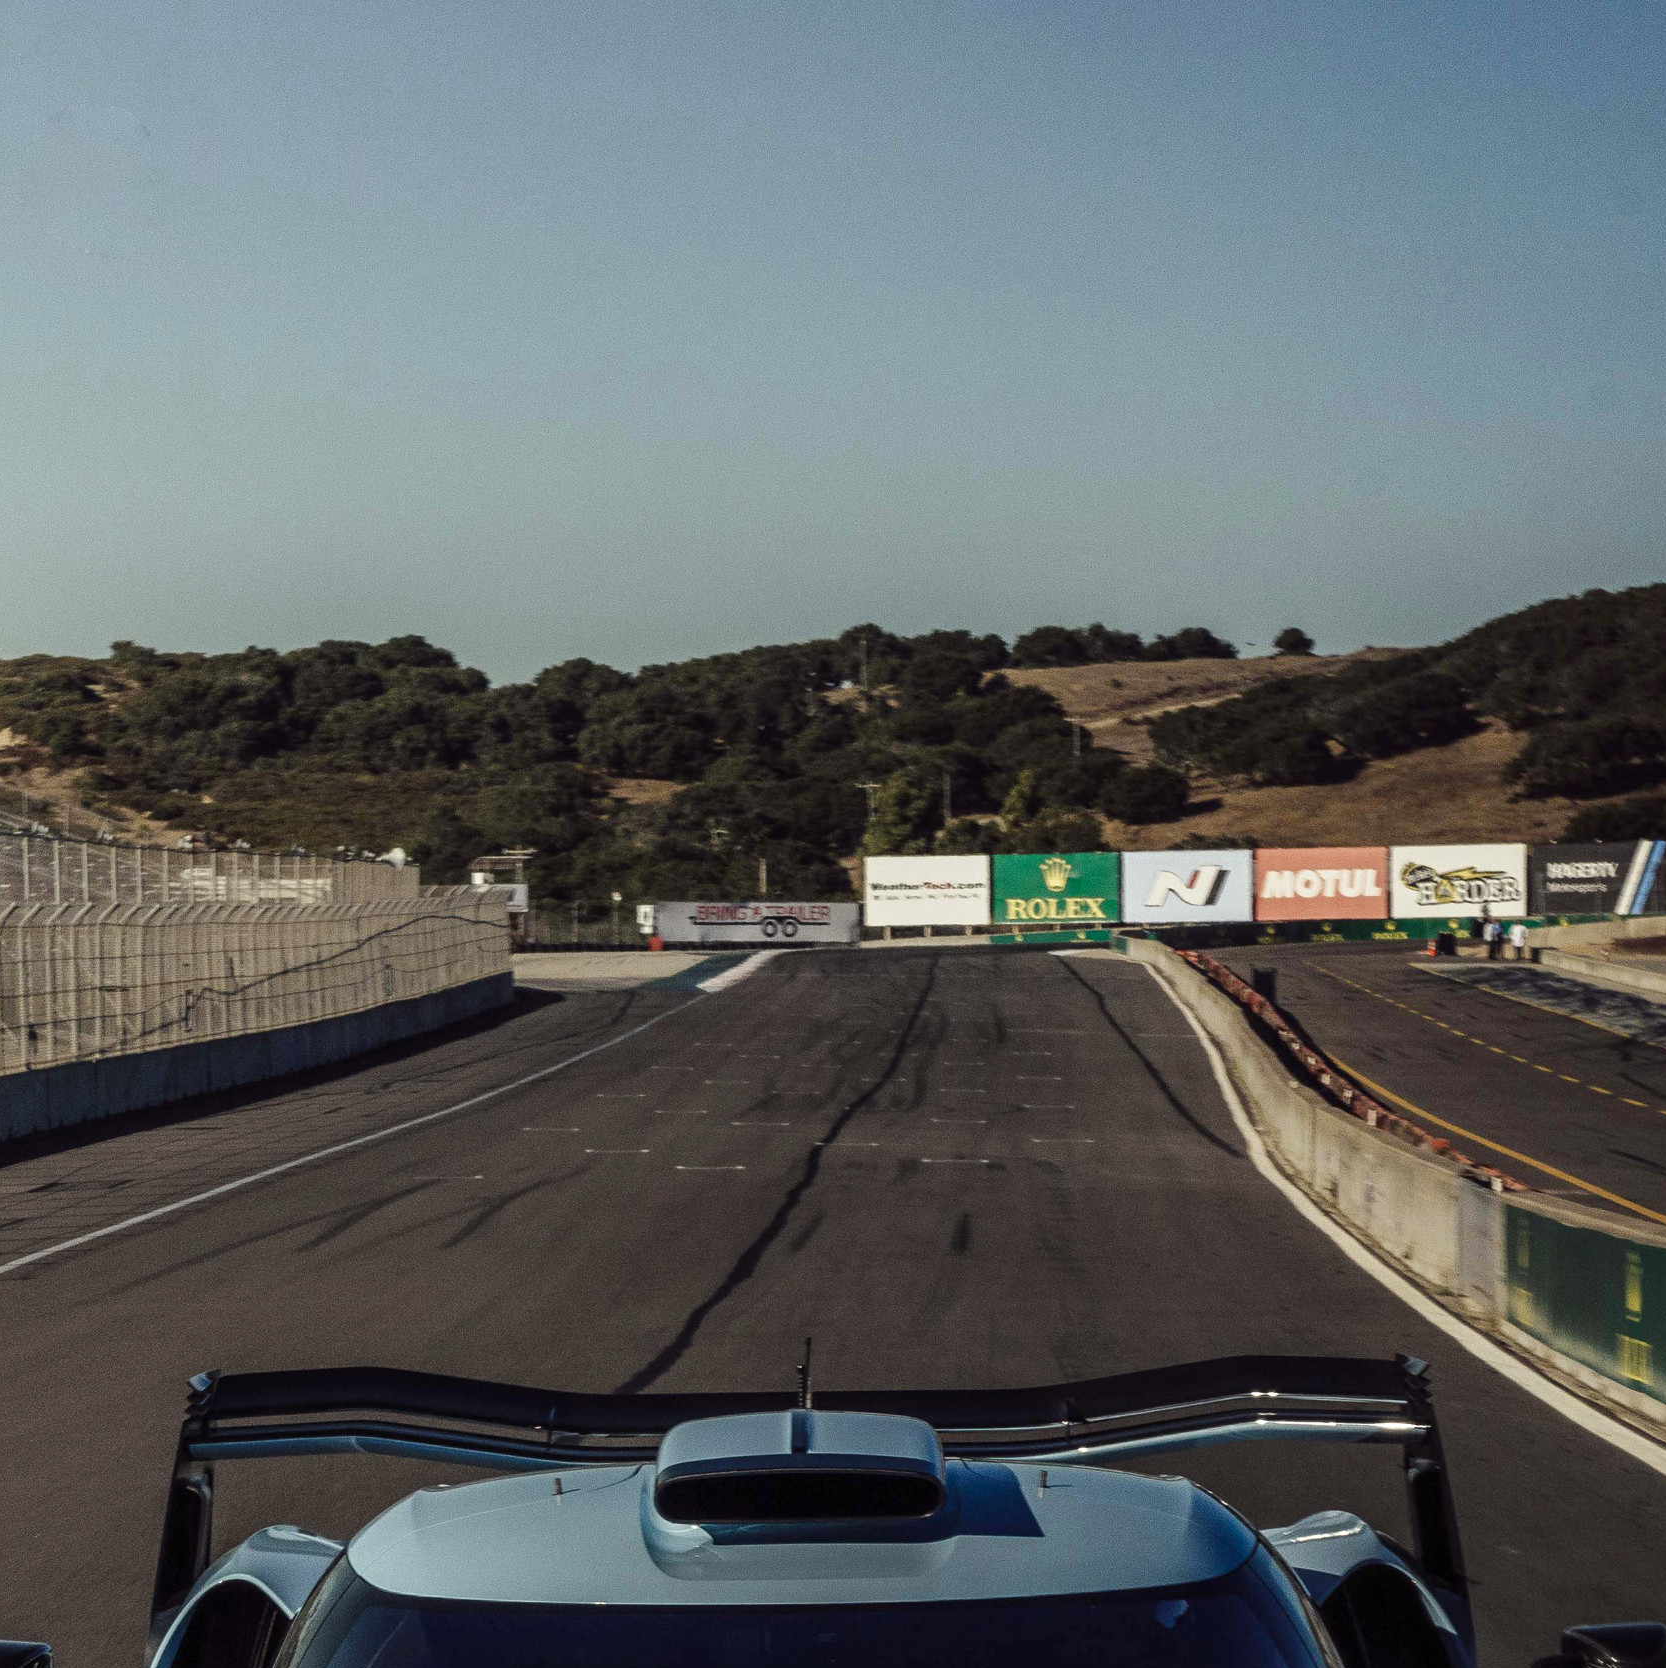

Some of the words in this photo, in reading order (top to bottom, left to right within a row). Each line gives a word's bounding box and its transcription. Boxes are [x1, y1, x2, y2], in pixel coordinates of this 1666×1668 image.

[1546, 862, 1620, 878] HAGERTY
[1261, 868, 1382, 898] MOTUL
[1417, 876, 1522, 904] HARDER
[696, 904, 747, 921] BRING
[752, 905, 762, 917] A
[764, 904, 831, 921] TRAILER
[1004, 897, 1107, 920] ROLEX
